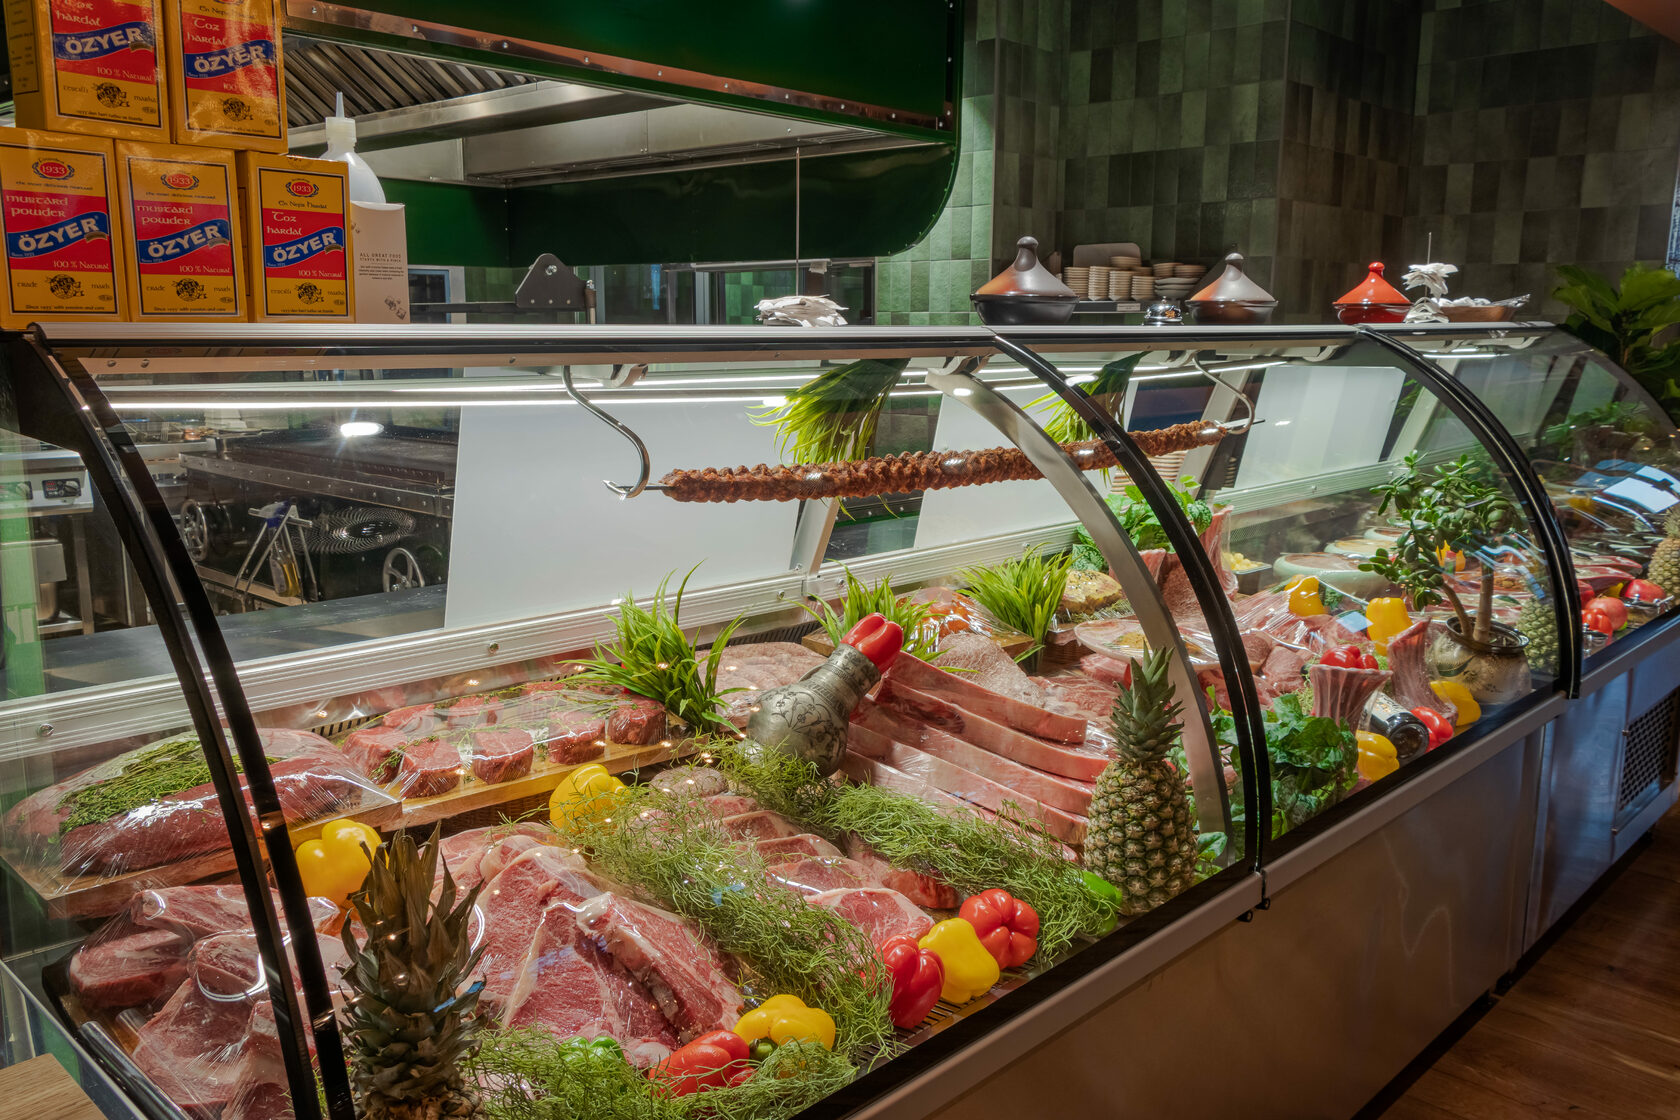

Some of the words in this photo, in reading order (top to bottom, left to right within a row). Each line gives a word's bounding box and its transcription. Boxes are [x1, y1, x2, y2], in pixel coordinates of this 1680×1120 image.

[56, 10, 101, 26] hardal
[192, 16, 219, 31] Toz
[65, 28, 143, 54] ÖZYER
[187, 32, 227, 46] hardal
[194, 46, 266, 73] ÖZYER
[97, 67, 112, 76] 100
[122, 70, 152, 80] Natural
[42, 166, 65, 174] 1933
[170, 176, 190, 184] 1933
[6, 194, 68, 206] mustard
[10, 207, 66, 217] powder
[136, 205, 192, 214] mustard
[142, 216, 191, 225] powder
[272, 211, 296, 222] Toz
[18, 218, 99, 251] ÖZYER
[266, 226, 302, 235] hardal
[148, 225, 220, 257] ÖZYER
[273, 233, 336, 262] ÖZYER
